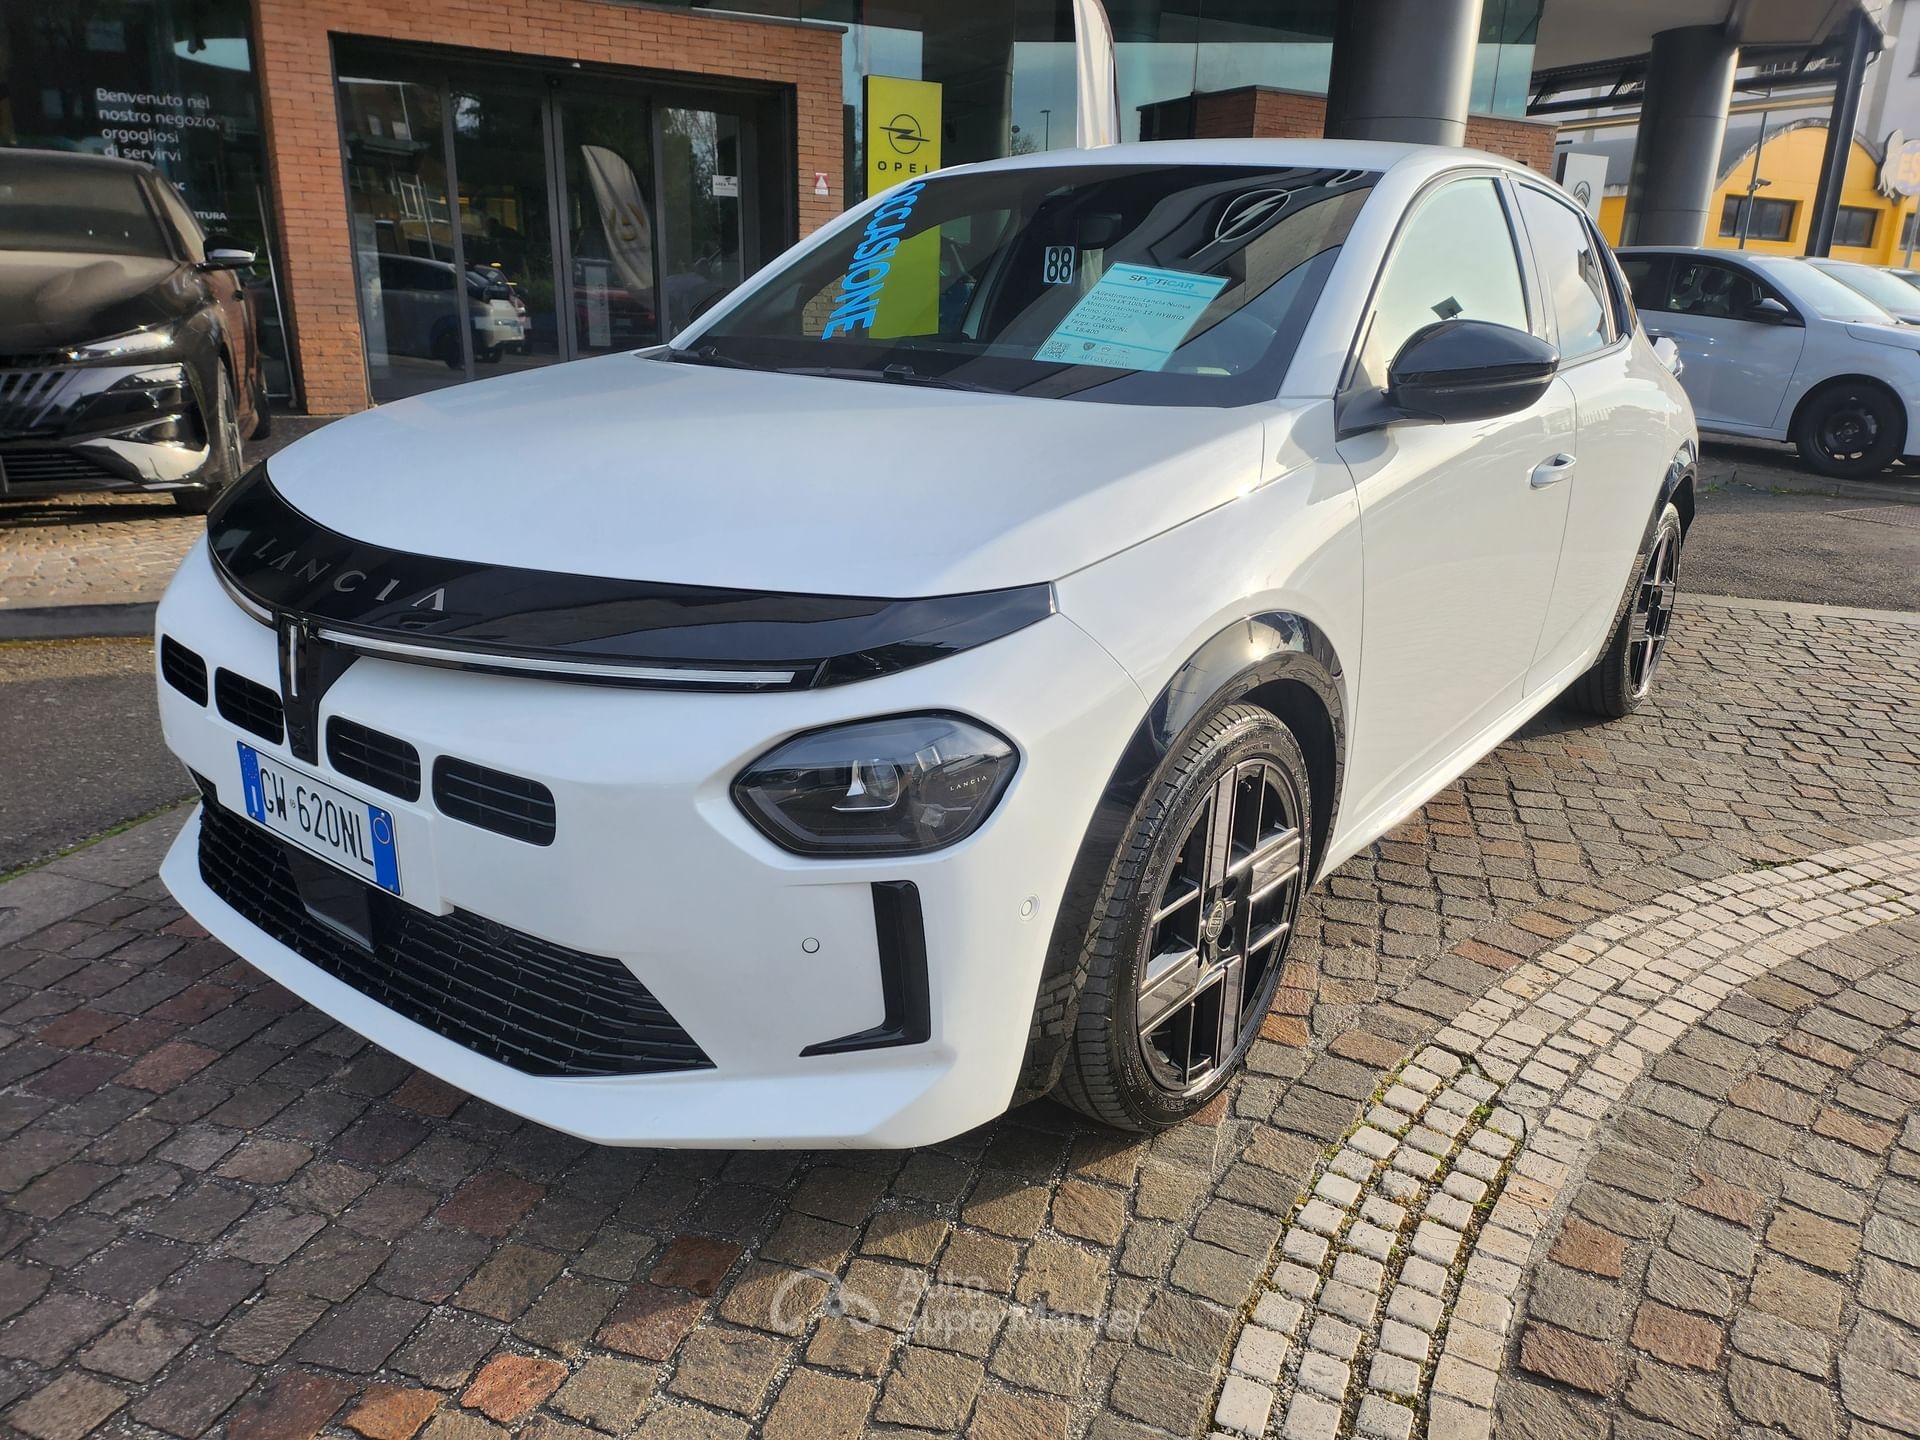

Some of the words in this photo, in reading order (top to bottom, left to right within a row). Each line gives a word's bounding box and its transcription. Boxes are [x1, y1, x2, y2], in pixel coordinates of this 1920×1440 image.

[96, 87, 184, 108] Benvenuto
[187, 95, 211, 109] nel
[99, 107, 151, 123] nostro
[102, 127, 180, 145] orgogliosi
[104, 143, 119, 158] di
[123, 147, 182, 161] servirvi
[194, 210, 228, 220] RTURA
[820, 181, 928, 341] OCCASIONE
[253, 536, 447, 612] LANCIA
[949, 774, 988, 792] LANCIA
[260, 767, 288, 822] GW
[296, 785, 375, 867] 620NL
